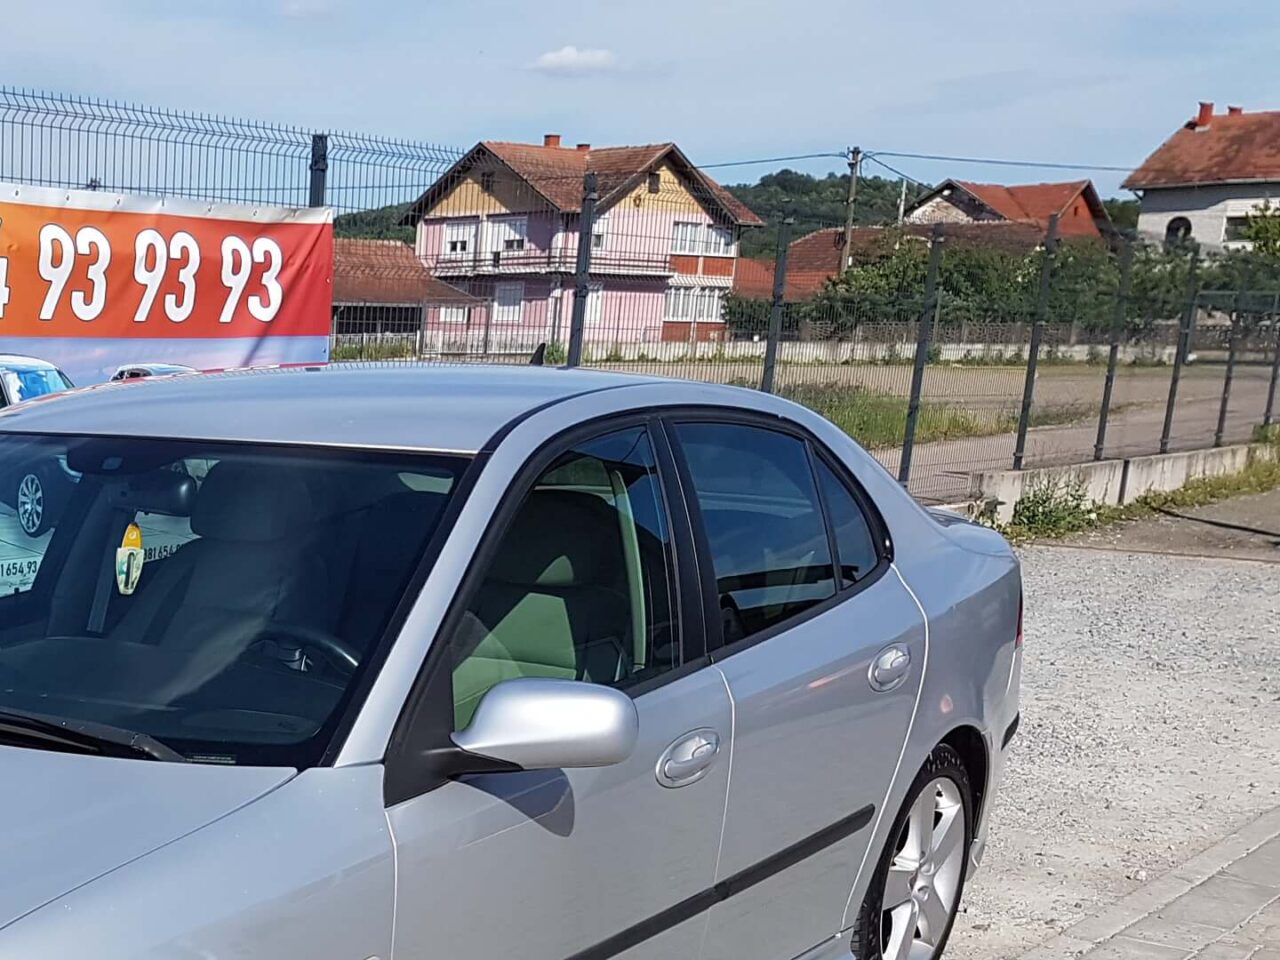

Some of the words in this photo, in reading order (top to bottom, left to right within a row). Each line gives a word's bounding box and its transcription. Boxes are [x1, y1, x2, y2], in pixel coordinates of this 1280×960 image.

[37, 223, 112, 321] 93
[132, 228, 202, 323] 93
[219, 235, 284, 323] 93
[6, 561, 25, 577] 654
[27, 560, 38, 575] 93
